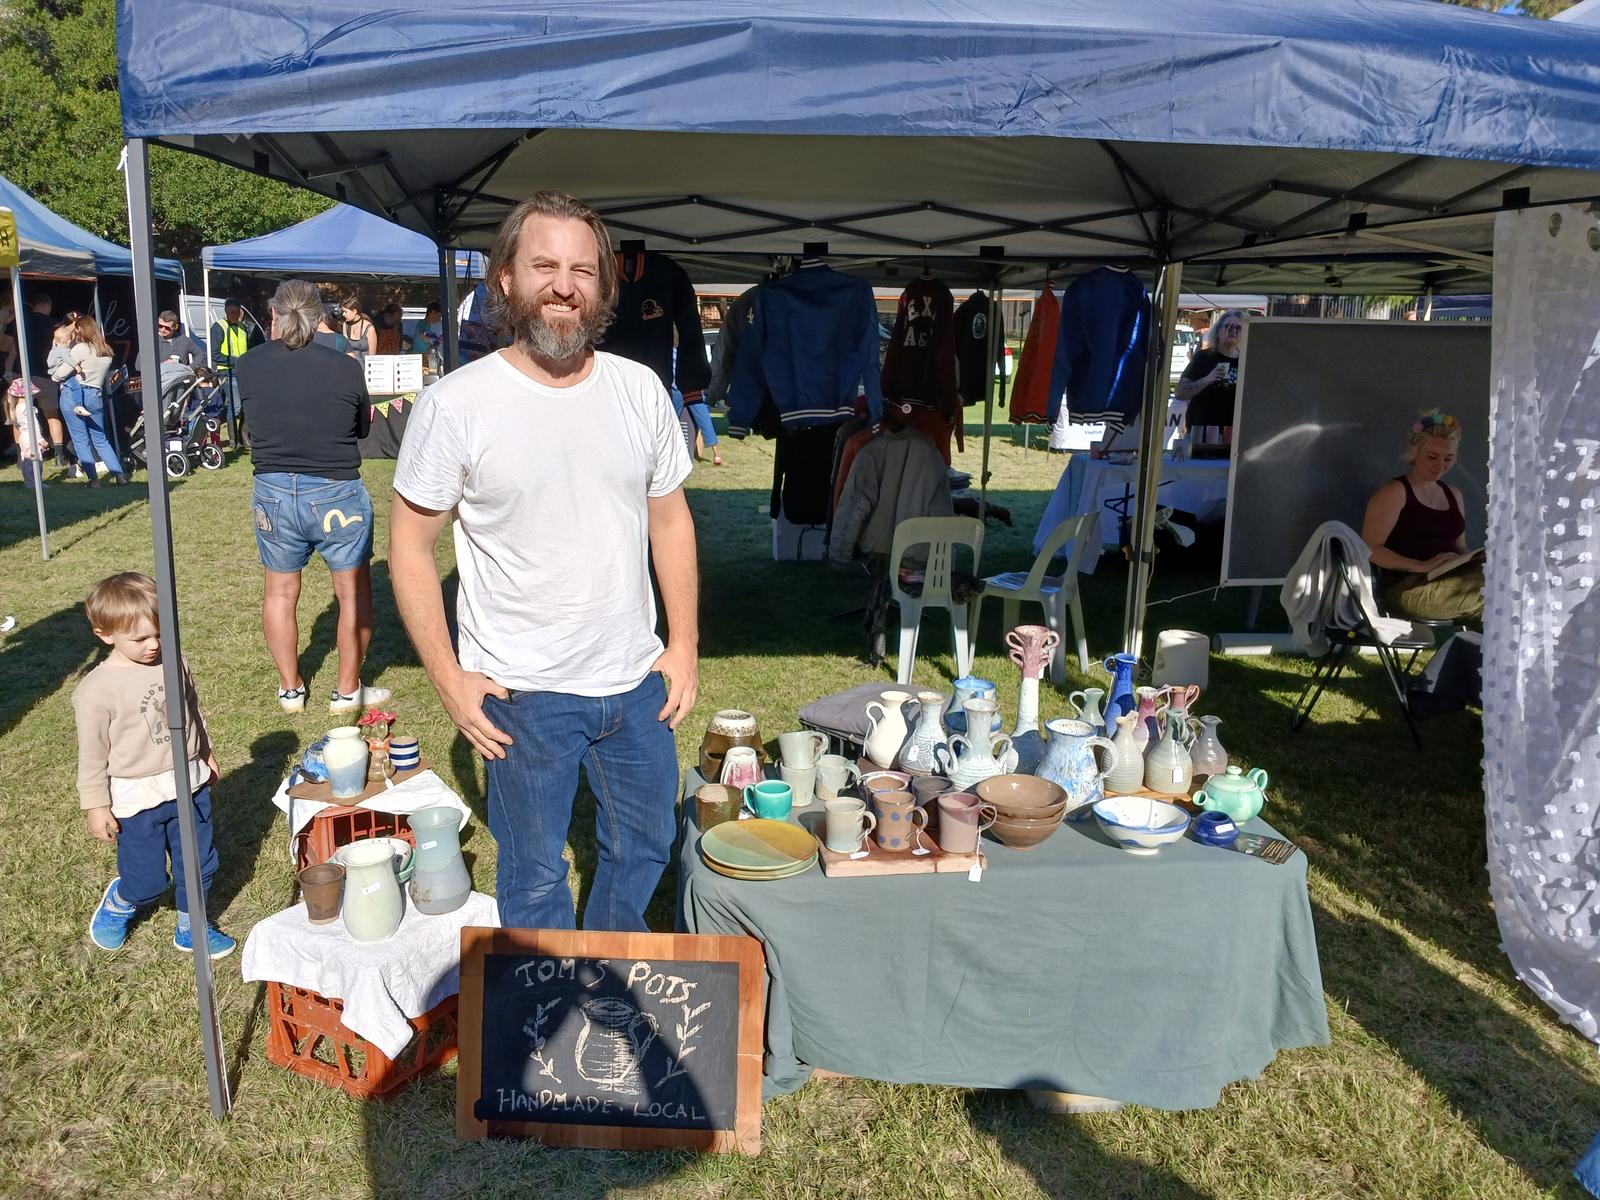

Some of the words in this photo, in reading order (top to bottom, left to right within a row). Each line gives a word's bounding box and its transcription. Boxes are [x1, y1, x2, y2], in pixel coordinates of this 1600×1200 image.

[140, 689, 155, 714] WILD
[155, 735, 171, 745] RO
[515, 958, 610, 988] TOM'S
[626, 961, 699, 1004] POTS
[633, 1101, 706, 1120] LOCAL
